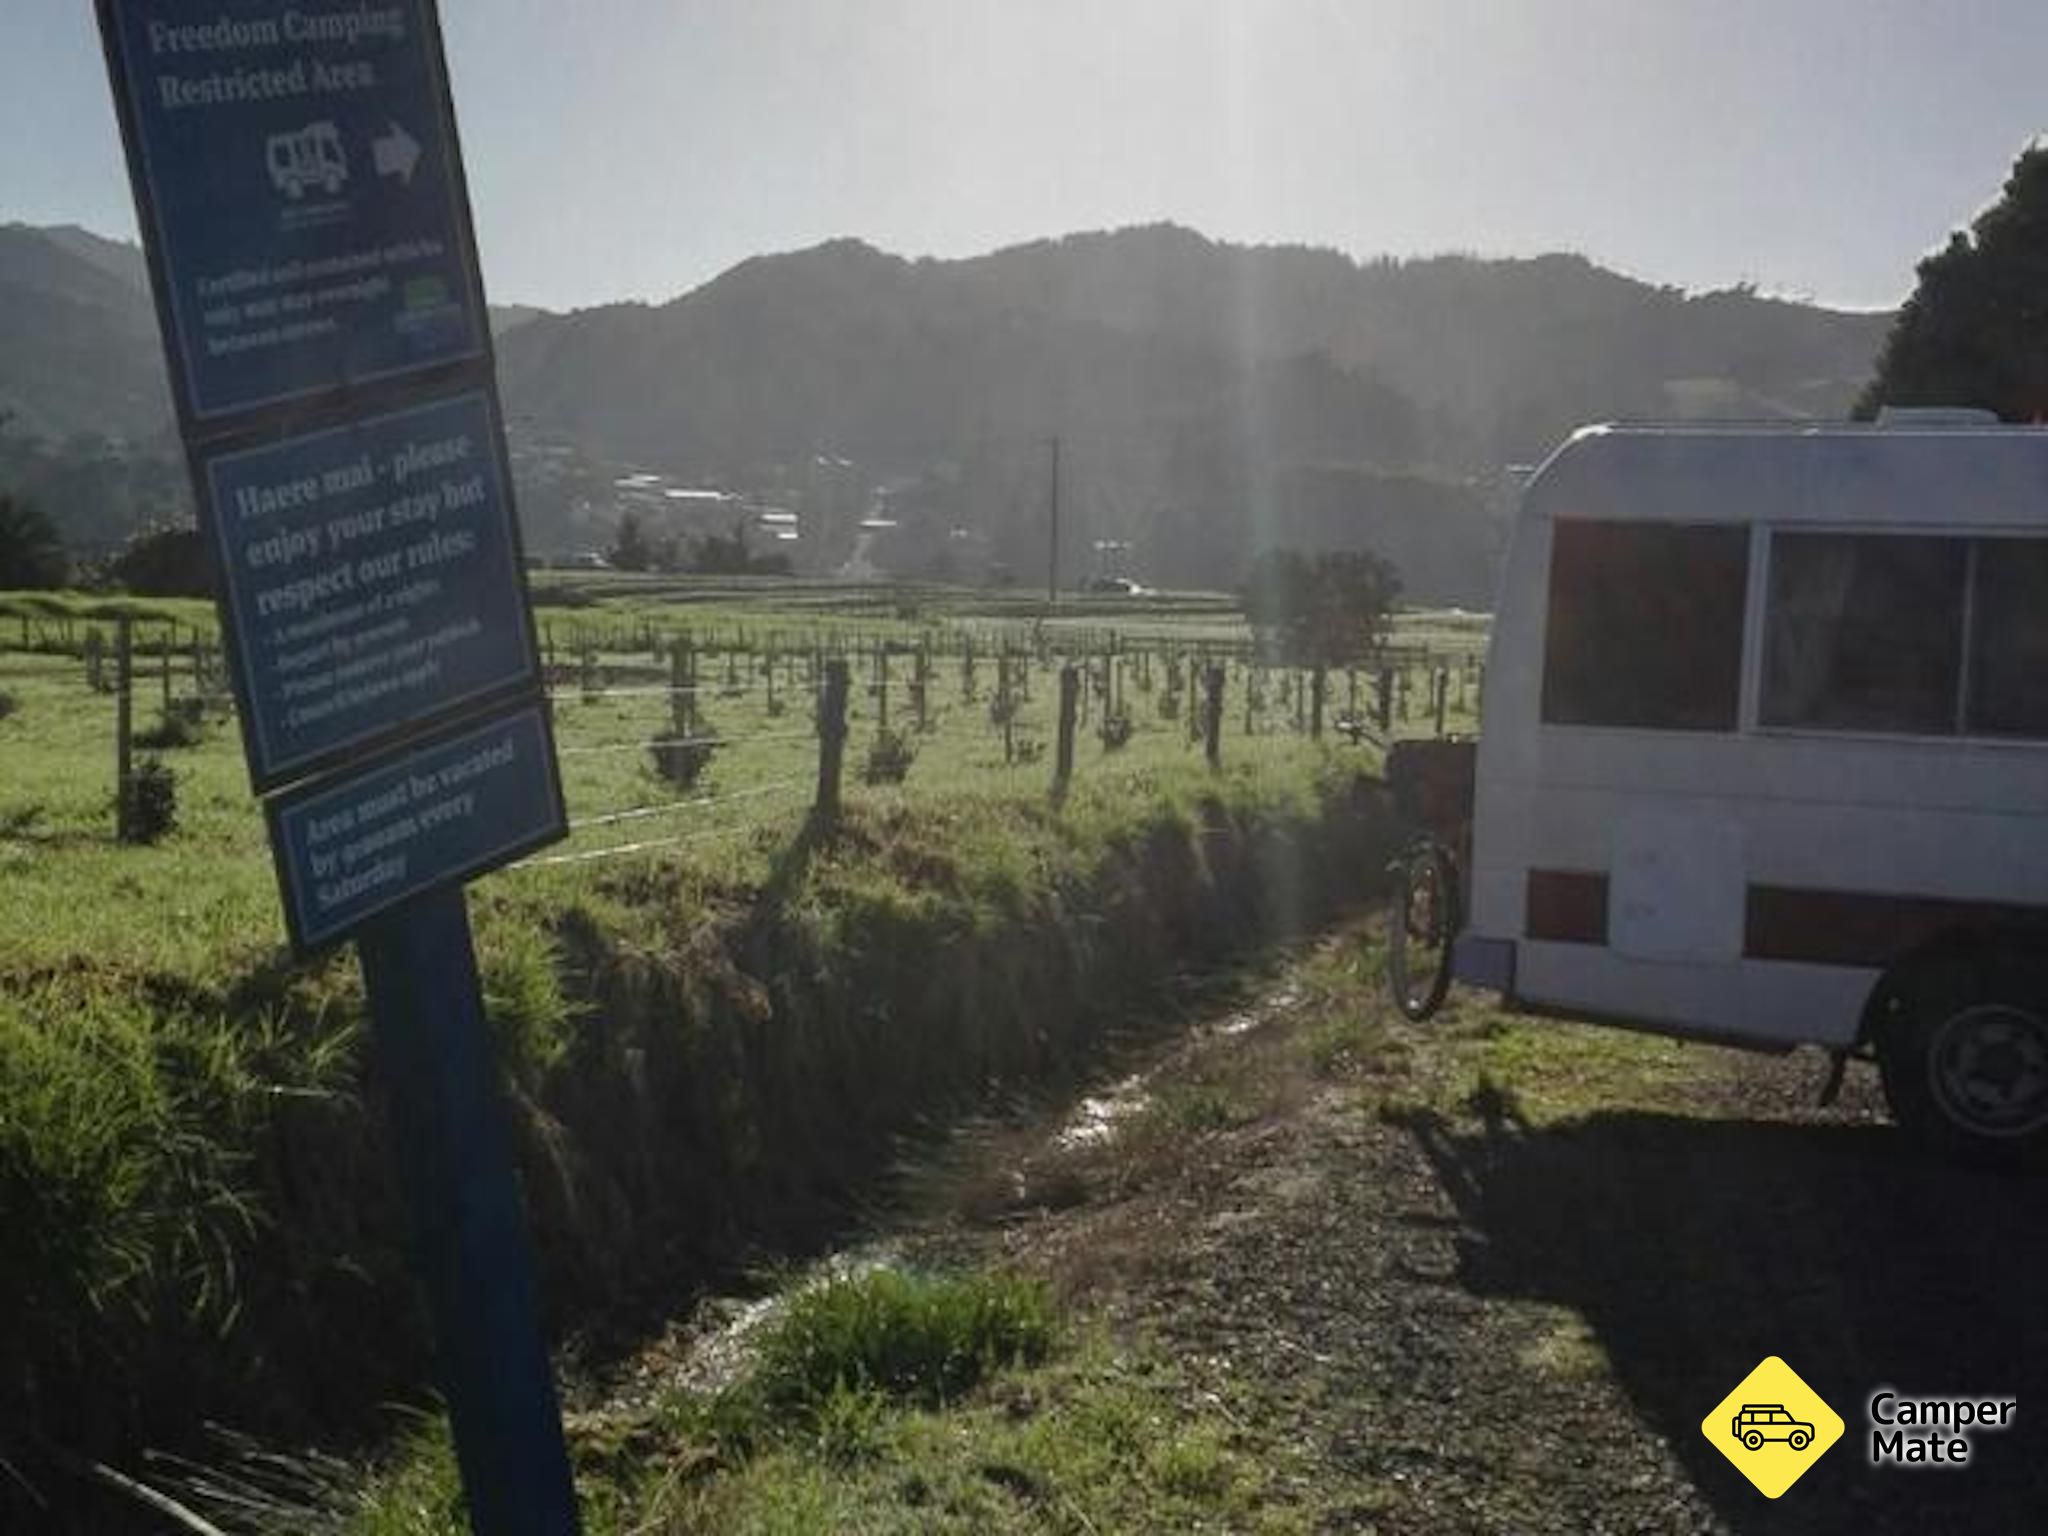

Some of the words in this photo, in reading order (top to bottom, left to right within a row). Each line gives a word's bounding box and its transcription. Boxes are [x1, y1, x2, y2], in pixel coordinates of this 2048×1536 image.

[150, 15, 279, 53] Freedom
[282, 3, 405, 44] Camping
[157, 59, 305, 107] Restricted
[311, 59, 375, 90] Area
[236, 477, 318, 517] Haere
[321, 453, 374, 494] mai
[394, 435, 471, 482] please
[247, 525, 320, 566] enjoy
[326, 507, 386, 548] your
[389, 491, 438, 525] stay
[441, 475, 486, 508] but
[257, 563, 354, 616] respect
[358, 551, 400, 582] our
[307, 809, 356, 846] Area
[409, 774, 438, 798] be
[438, 737, 513, 786] vacated
[309, 850, 337, 877] by
